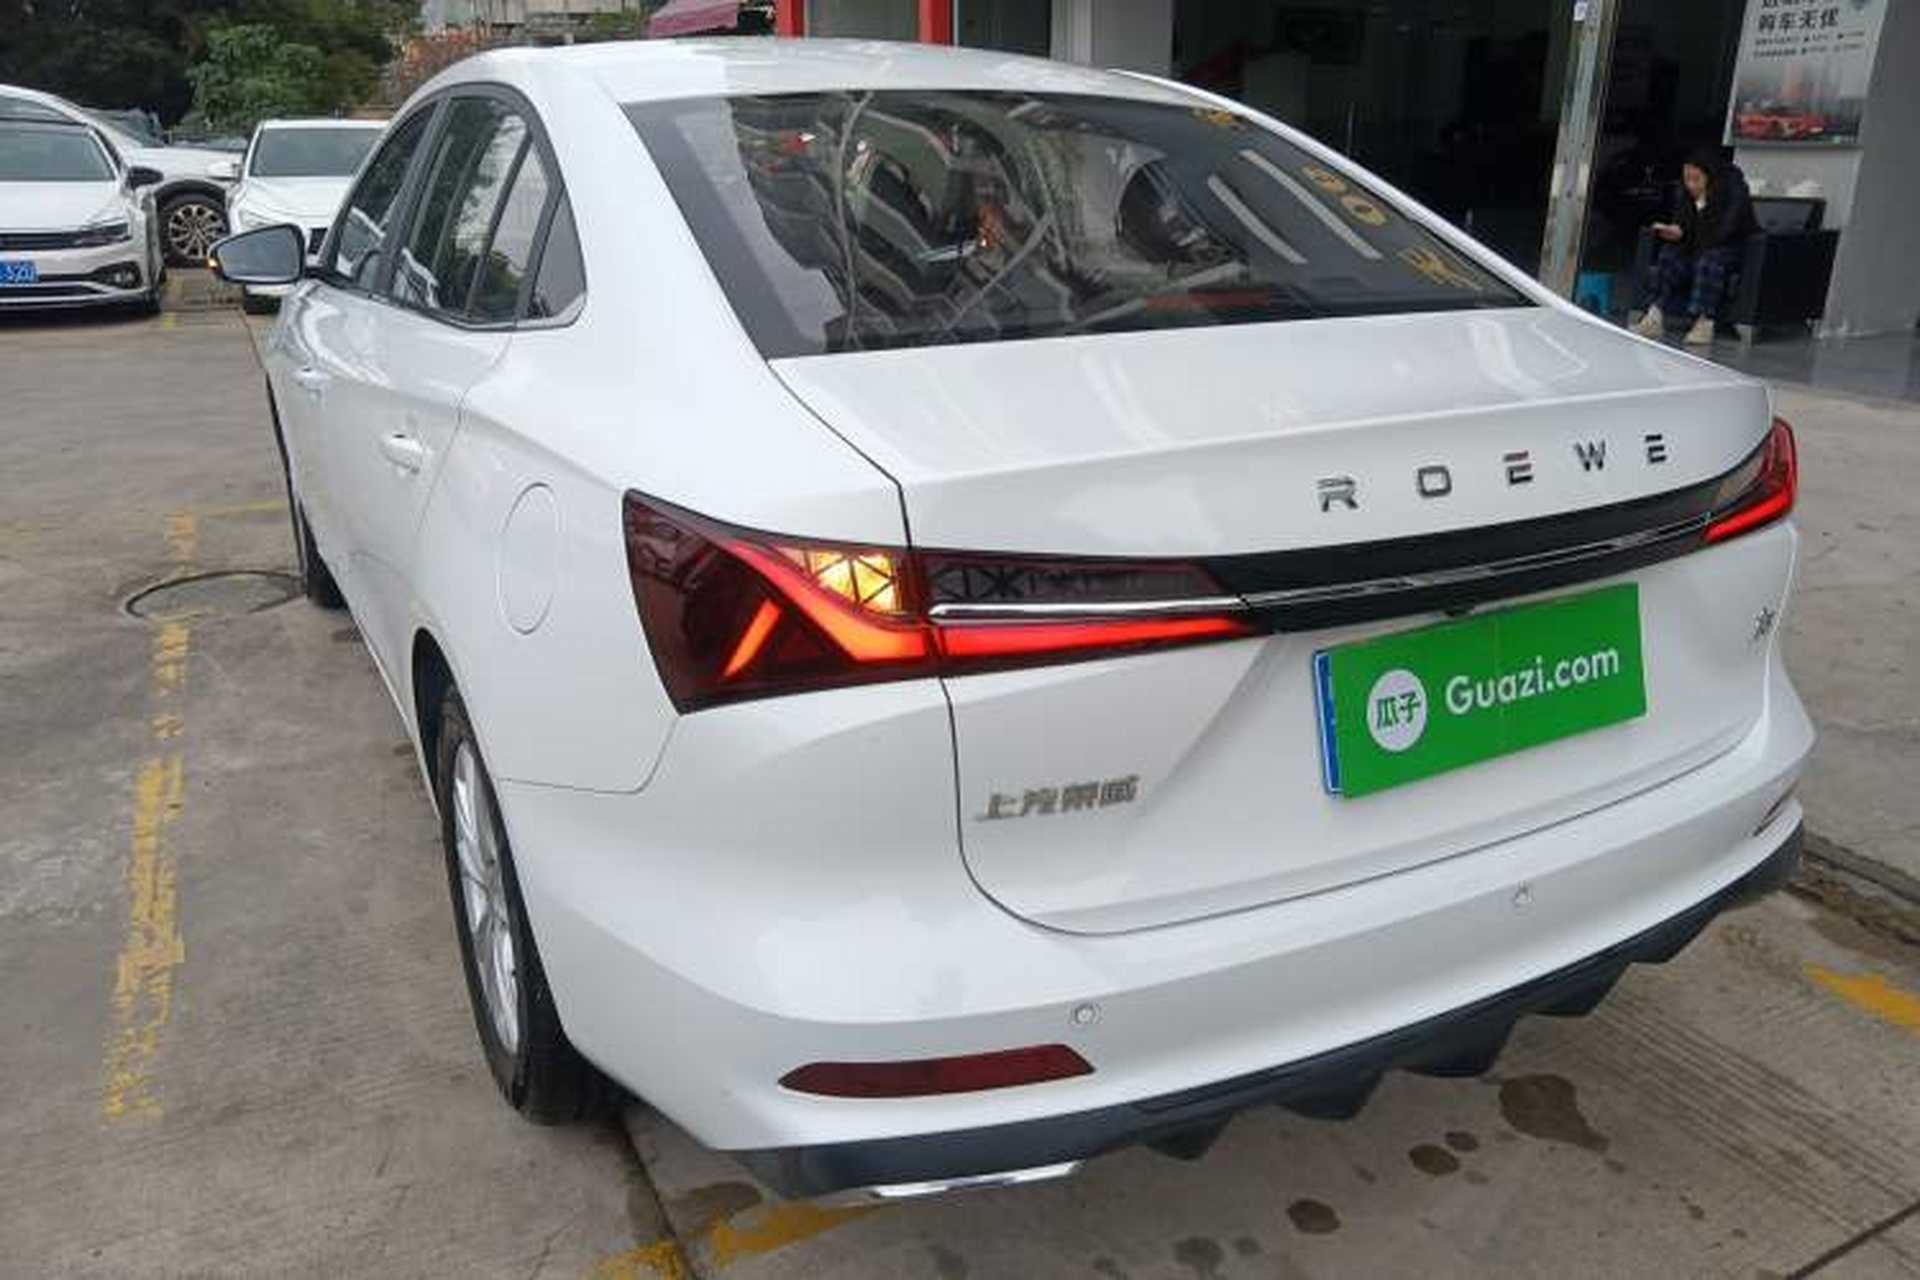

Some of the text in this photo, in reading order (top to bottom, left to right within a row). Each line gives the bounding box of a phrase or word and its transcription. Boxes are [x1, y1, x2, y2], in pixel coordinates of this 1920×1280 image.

[1317, 433, 1668, 512] ROEWE
[1376, 692, 1421, 730] 瓜子
[1446, 645, 1621, 716] Guazi.com
